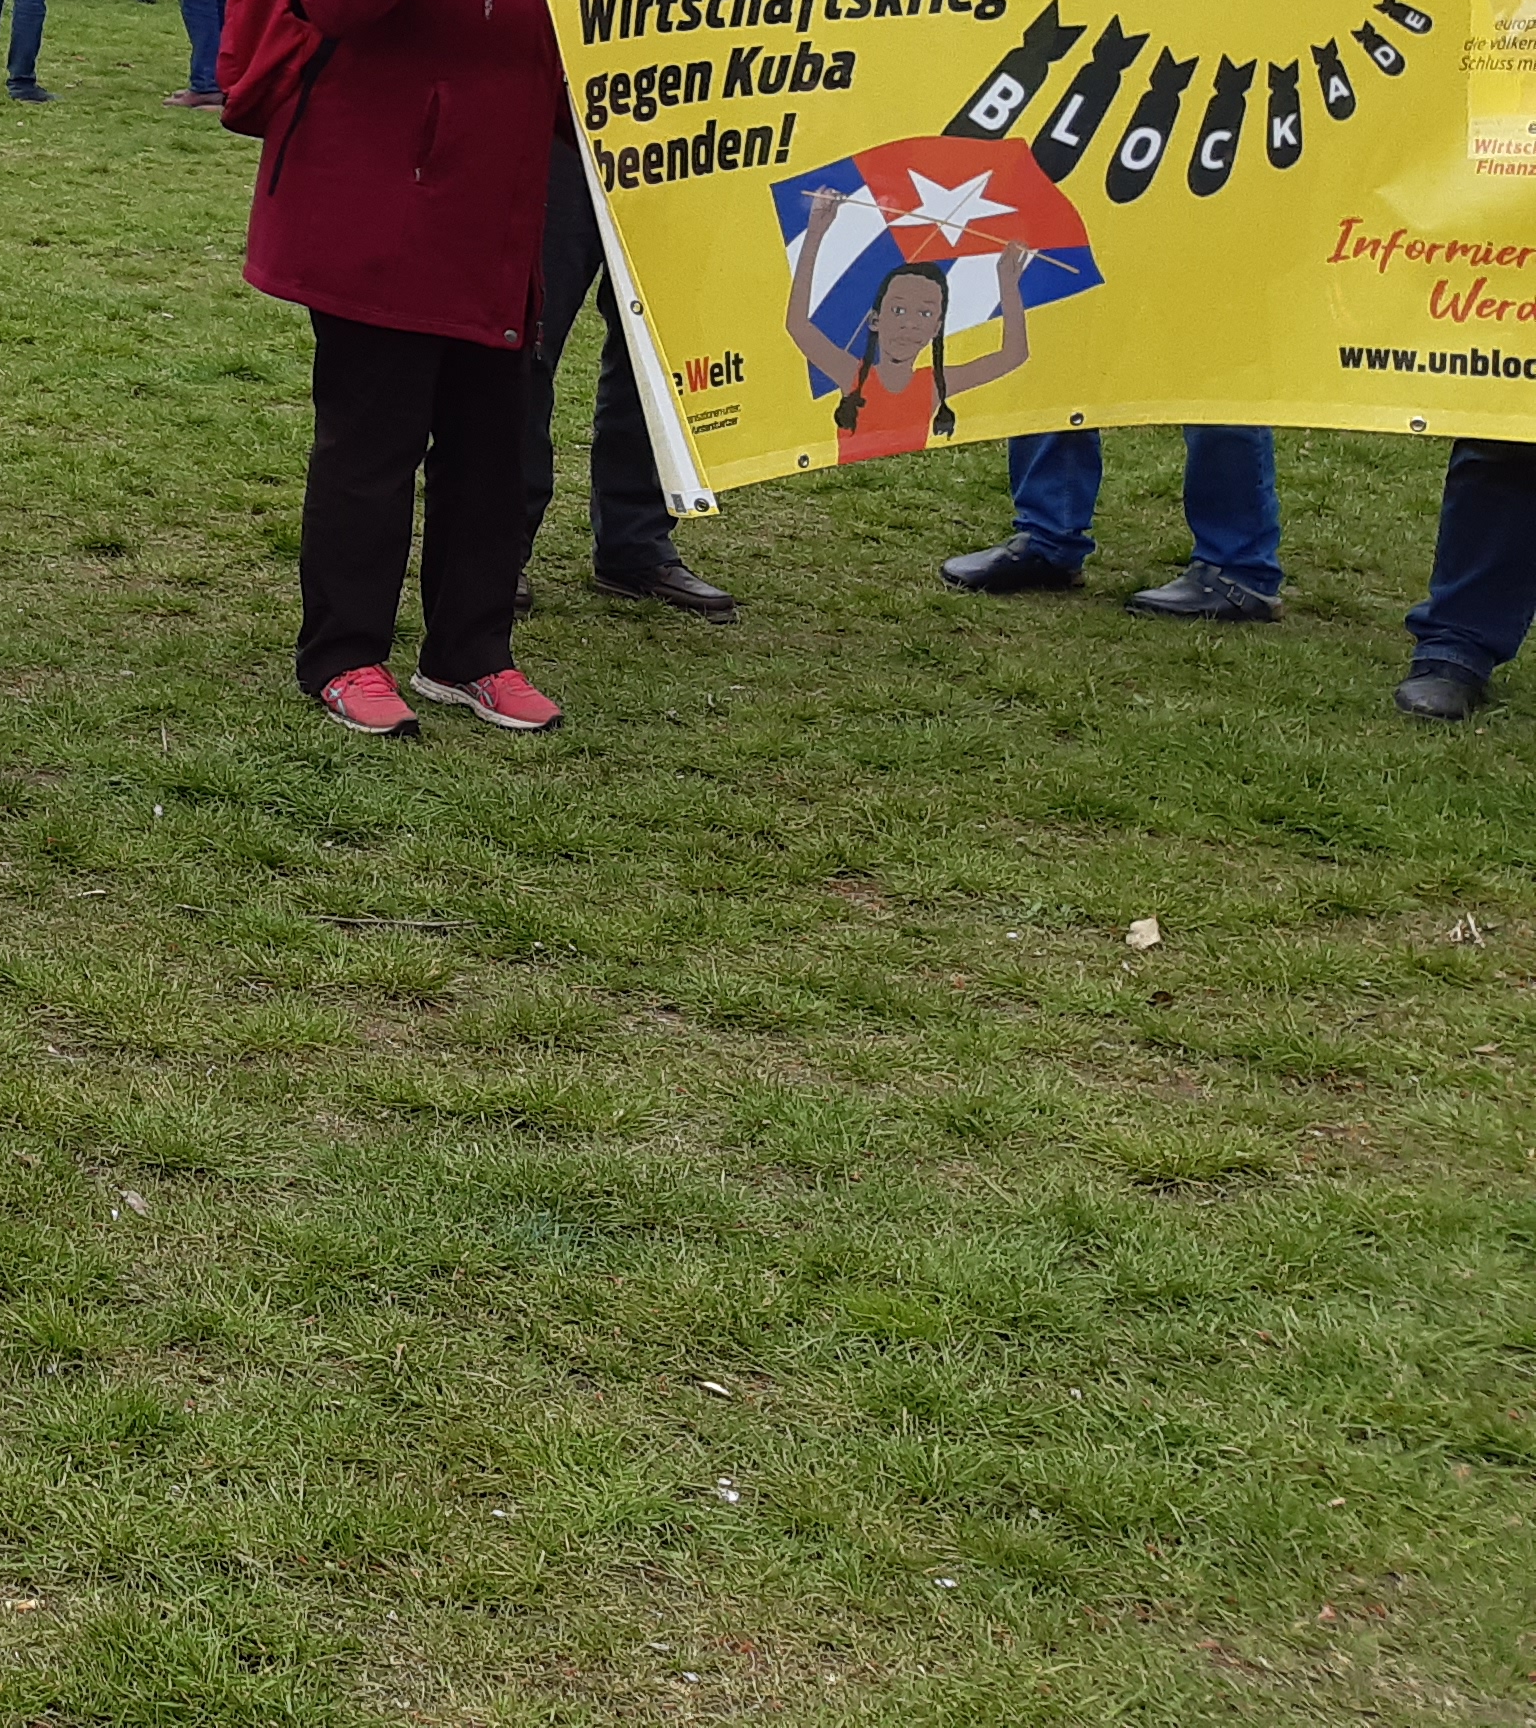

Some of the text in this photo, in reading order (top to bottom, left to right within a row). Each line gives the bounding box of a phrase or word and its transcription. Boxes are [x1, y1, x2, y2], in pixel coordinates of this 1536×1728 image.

[585, 41, 856, 132] gegen Kuba
[968, 13, 1426, 170] BLOCKADE
[1459, 55, 1513, 71] Schluss
[685, 351, 744, 392] Welt
